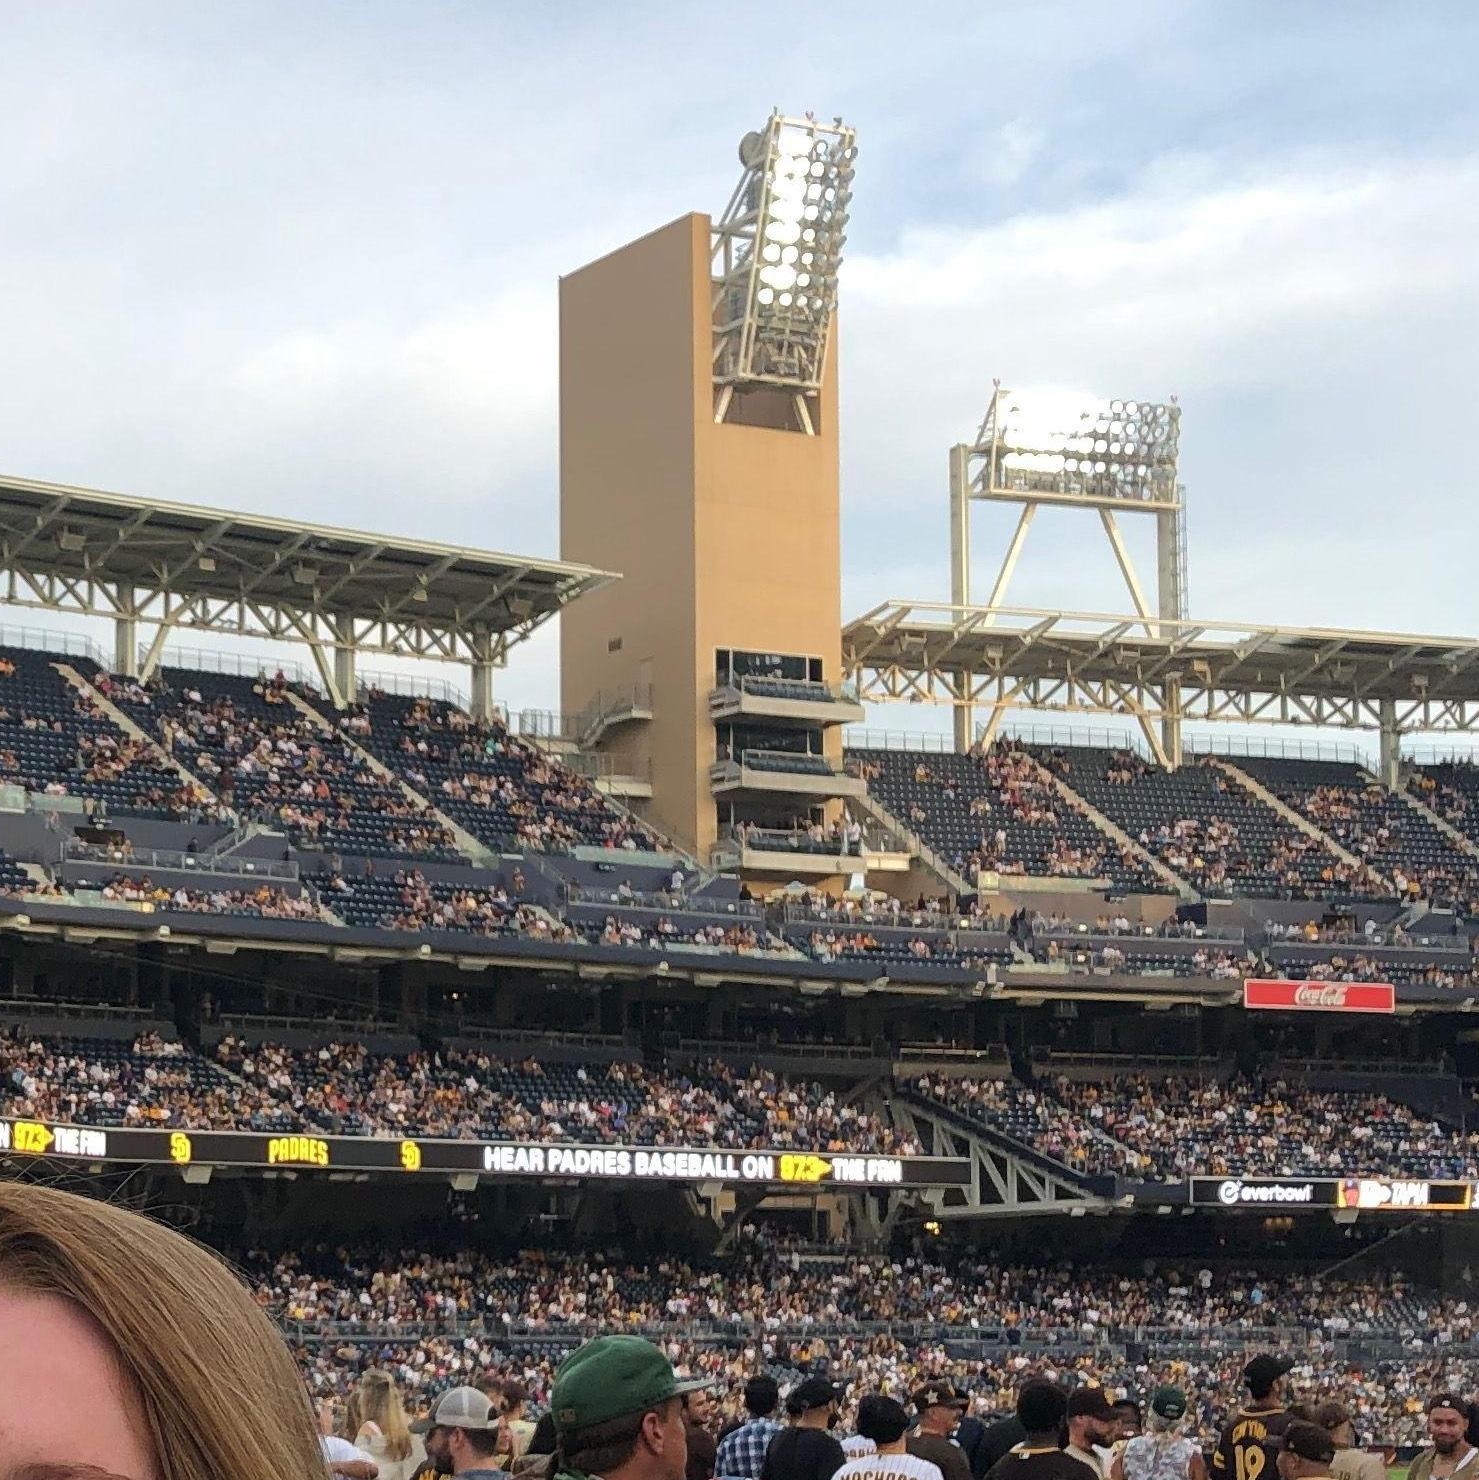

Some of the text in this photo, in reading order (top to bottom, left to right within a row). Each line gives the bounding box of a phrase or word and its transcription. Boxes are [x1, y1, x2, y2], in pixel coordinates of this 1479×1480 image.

[268, 1137, 328, 1166] PADRES
[484, 1146, 545, 1171] HEAR
[547, 1149, 633, 1175] PADRES
[635, 1152, 739, 1179] BASEBALL
[742, 1155, 773, 1179] ON
[1241, 1184, 1311, 1202] everbowl
